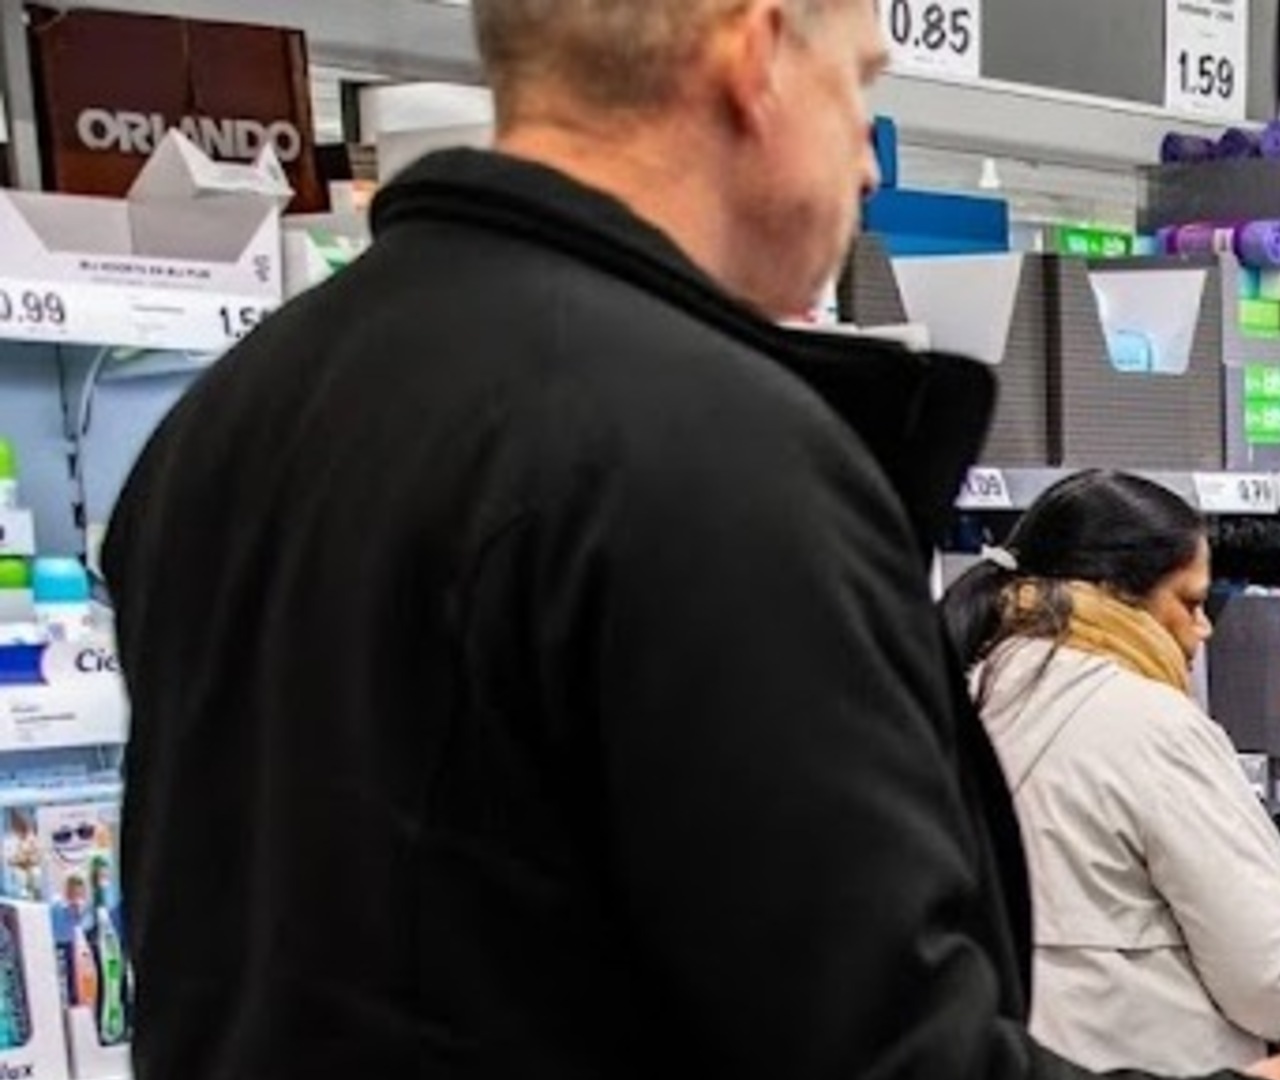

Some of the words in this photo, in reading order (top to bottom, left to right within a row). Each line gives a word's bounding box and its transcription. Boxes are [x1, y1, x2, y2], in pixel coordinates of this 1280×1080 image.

[891, 0, 971, 55] 0.85
[1178, 50, 1235, 99] 1.59
[77, 107, 301, 163] ORLANDO
[219, 305, 272, 340] 1.5
[74, 647, 120, 673] Cie
